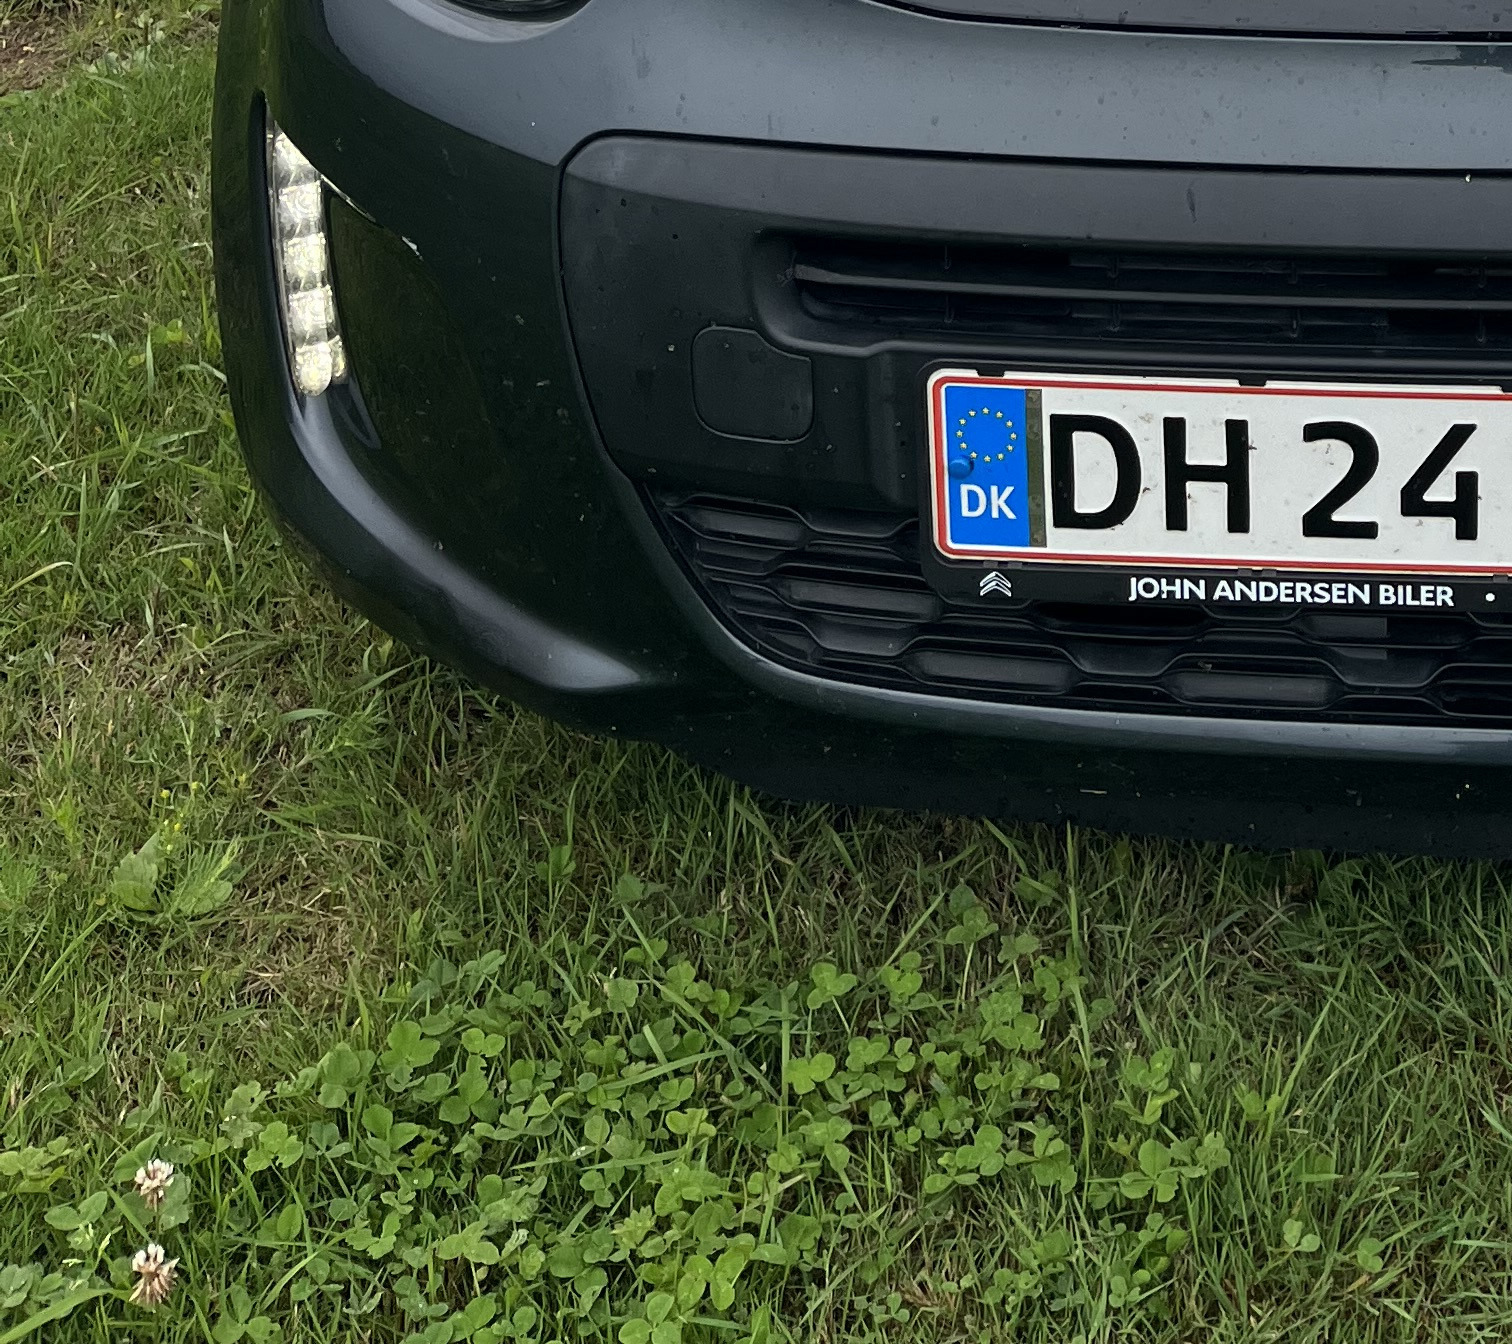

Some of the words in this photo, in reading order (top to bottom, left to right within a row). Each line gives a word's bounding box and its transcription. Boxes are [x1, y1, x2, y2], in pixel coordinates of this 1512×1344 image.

[1049, 413, 1250, 533] DH
[1302, 420, 1479, 541] 24
[960, 483, 1017, 520] DK
[1128, 576, 1206, 601] JOHN
[1213, 579, 1371, 605] ANDERSEN
[1378, 584, 1455, 607] BILER
